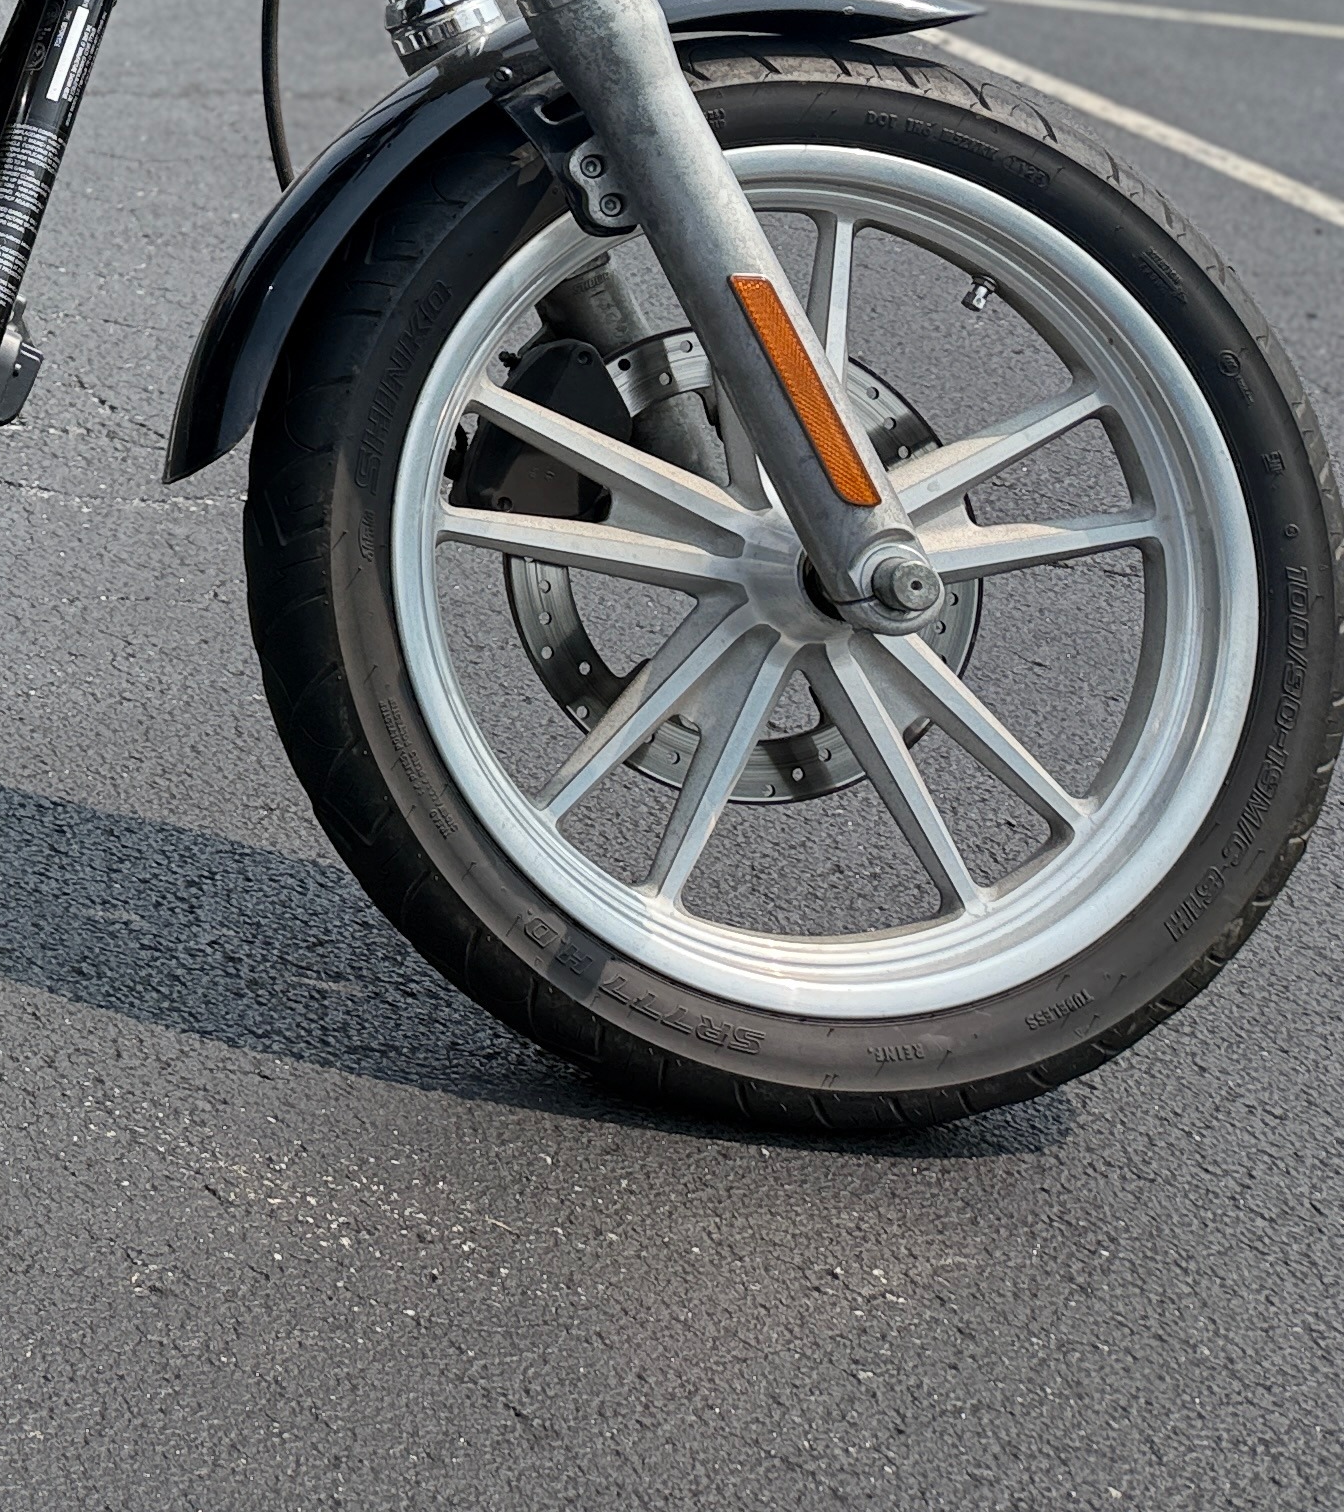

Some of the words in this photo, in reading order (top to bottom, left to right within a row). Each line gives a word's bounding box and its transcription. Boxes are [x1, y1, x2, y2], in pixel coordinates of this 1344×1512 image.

[351, 276, 457, 495] SHINKO
[594, 968, 765, 1056] SR777
[1021, 986, 1093, 1034] TUBELESS
